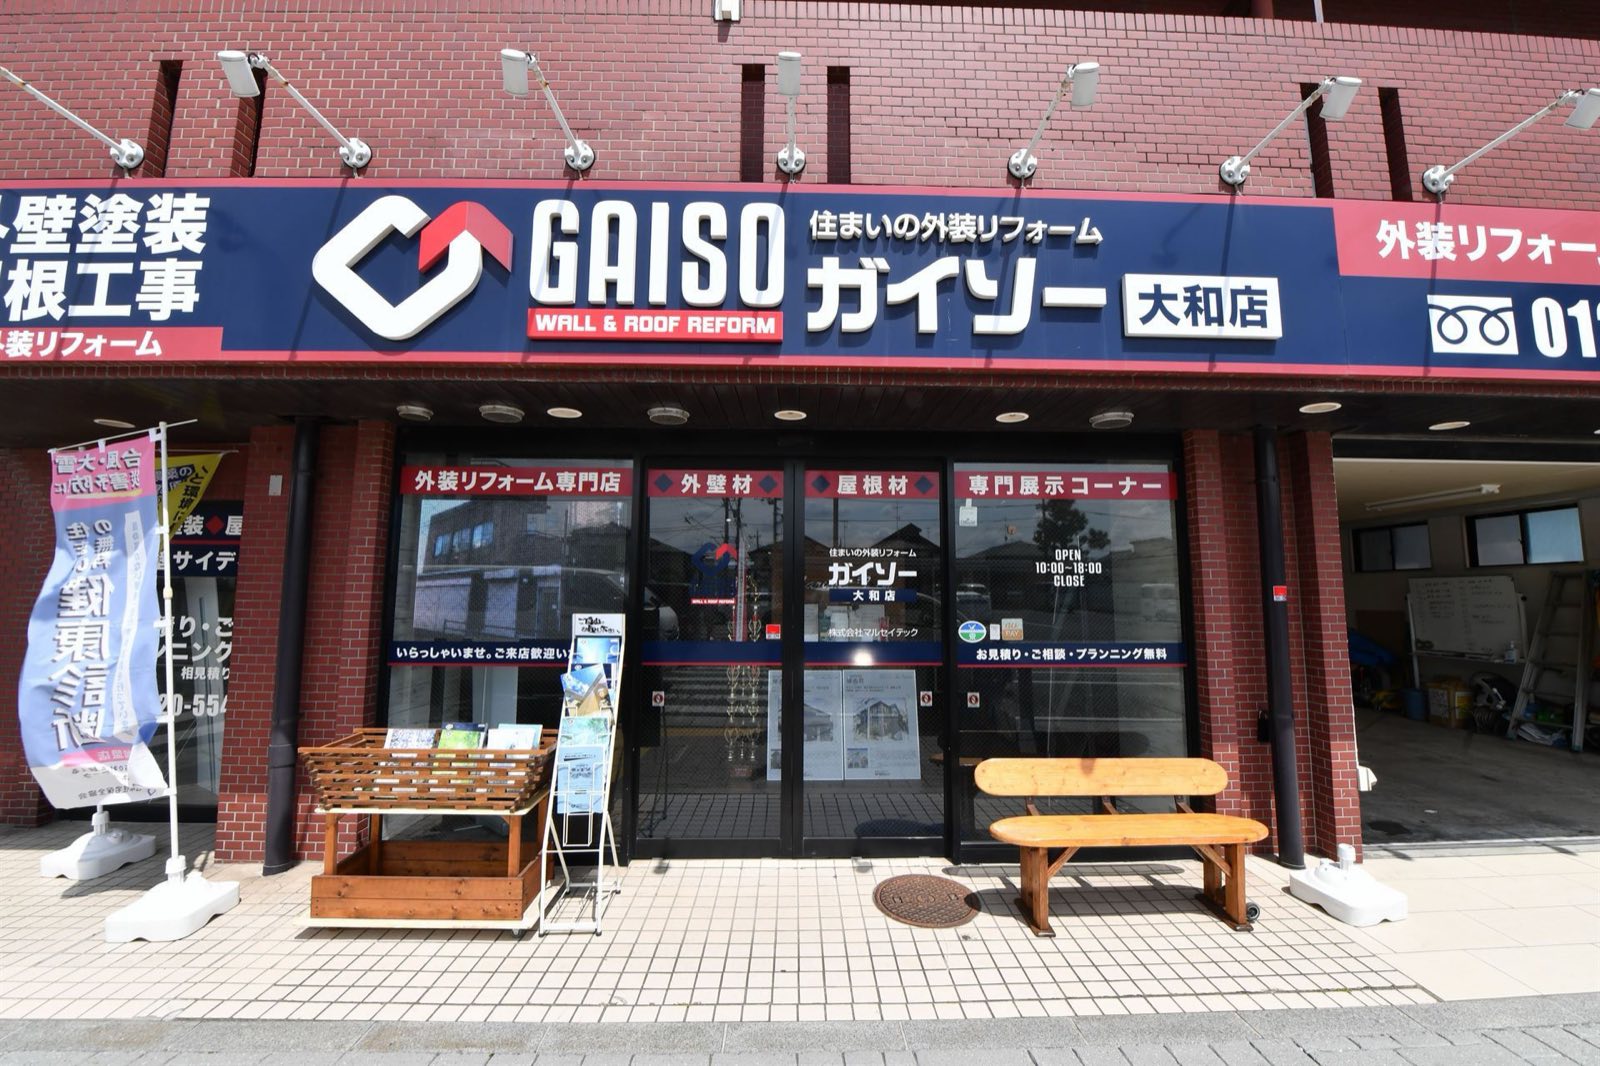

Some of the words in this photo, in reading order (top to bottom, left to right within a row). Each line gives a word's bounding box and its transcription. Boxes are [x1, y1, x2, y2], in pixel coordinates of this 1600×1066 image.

[0, 192, 210, 255] 壁塗装
[809, 209, 1103, 246] 住まいの外装リフォーム
[529, 199, 785, 307] GAISO
[1376, 219, 1600, 265] 外装リフォー
[0, 257, 203, 322] 根工事
[807, 256, 1107, 334] ガイソー
[1138, 283, 1269, 329] 大和店
[535, 314, 596, 332] WALL
[603, 315, 617, 332] &
[624, 316, 680, 333] ROOF
[688, 316, 775, 335] REFORM
[1531, 297, 1600, 358] 01
[0, 330, 163, 358] 装リフォーム
[414, 470, 621, 493] 外装リフォーム専門店
[680, 473, 753, 495] 外壁材
[836, 475, 909, 496] 屋根材
[968, 475, 1162, 496] 専門展示コーナー
[829, 548, 917, 558] 住まいの外装リフォーム
[1055, 548, 1081, 561] OPEN
[828, 561, 917, 586] ガイソー
[1053, 574, 1085, 587] CLOSE
[852, 589, 896, 602] 大和店
[828, 627, 919, 638] 株式会社マルセイテック
[976, 648, 1167, 661] お見積り・ご相談・プランニング無料
